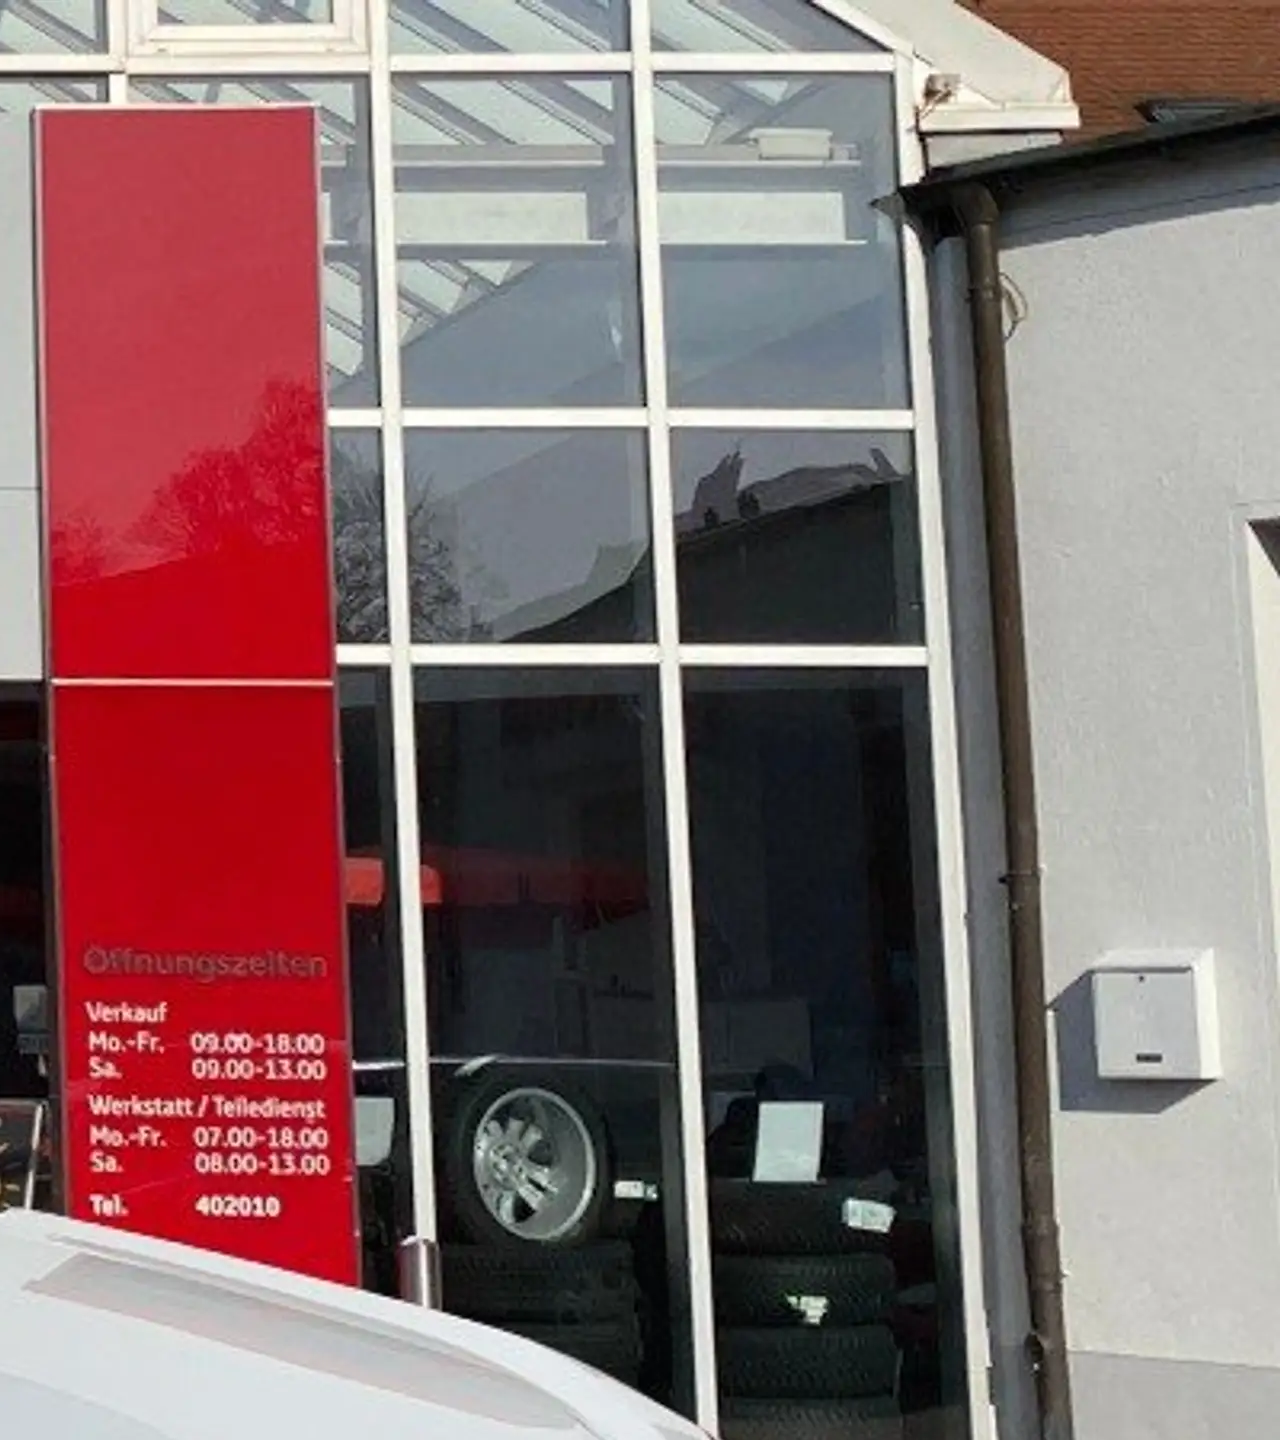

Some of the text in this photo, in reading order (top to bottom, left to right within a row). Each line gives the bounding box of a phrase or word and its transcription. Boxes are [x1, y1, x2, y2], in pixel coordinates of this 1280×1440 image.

[83, 945, 328, 983] Öffnungszeiten
[85, 1002, 168, 1024] Verkauf
[88, 1031, 166, 1054] Mo.-Fr.
[88, 1058, 327, 1081] Sa. 09.00-13.00
[88, 1095, 327, 1119] Werkstatt / Teiledienst
[89, 1126, 329, 1149] Mo.-Fr. 07.00-18.00
[91, 1153, 331, 1176] Sa. 08.00-13.00
[90, 1194, 282, 1218] Tel. 402010
